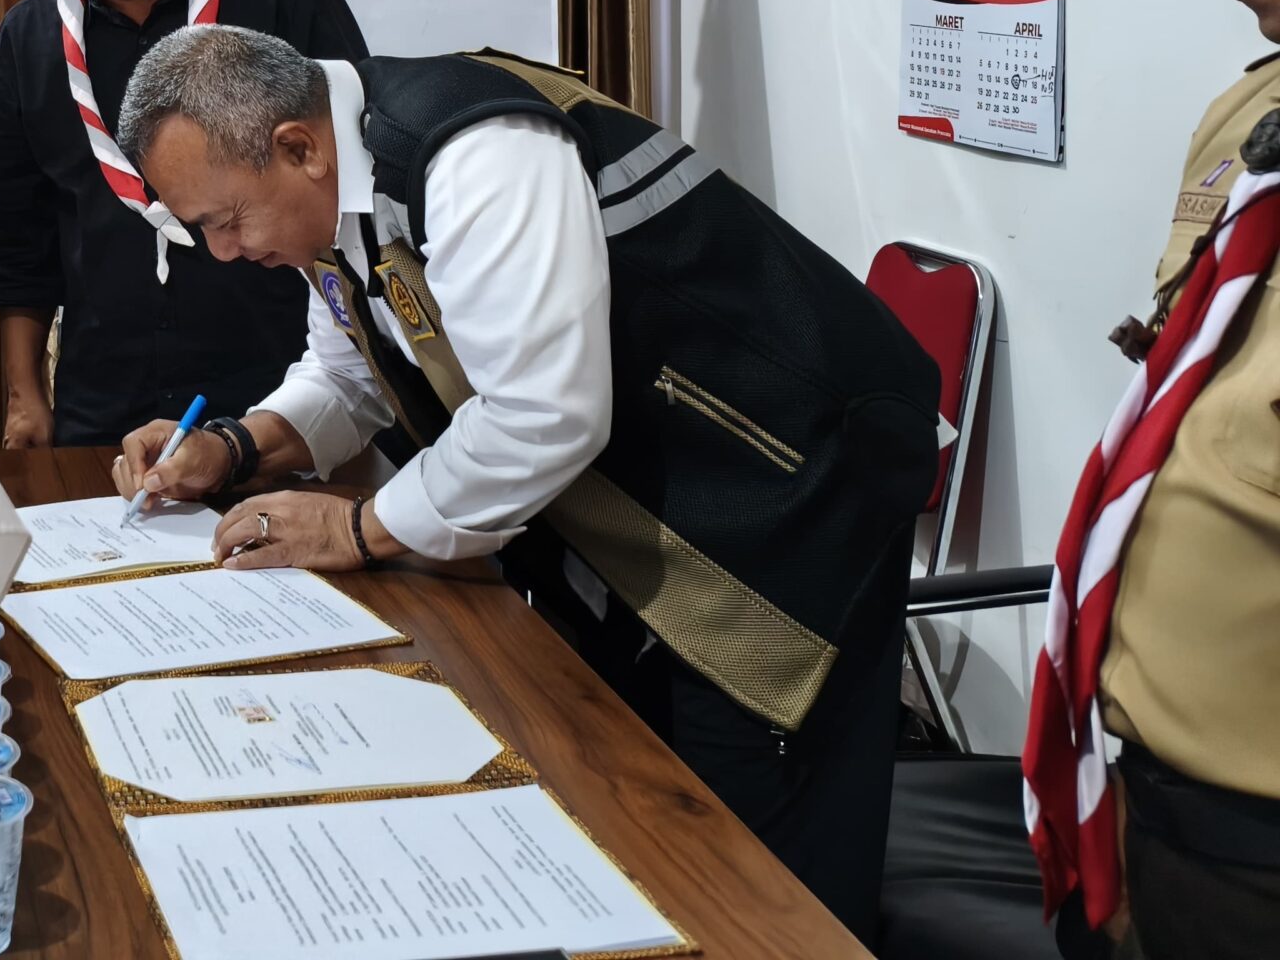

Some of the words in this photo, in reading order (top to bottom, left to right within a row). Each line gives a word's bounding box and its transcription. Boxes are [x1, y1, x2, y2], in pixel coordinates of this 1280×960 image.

[936, 14, 964, 29] MARET
[1014, 22, 1043, 37] APRIL
[1003, 92, 1009, 100] 22
[1012, 93, 1018, 101] 23
